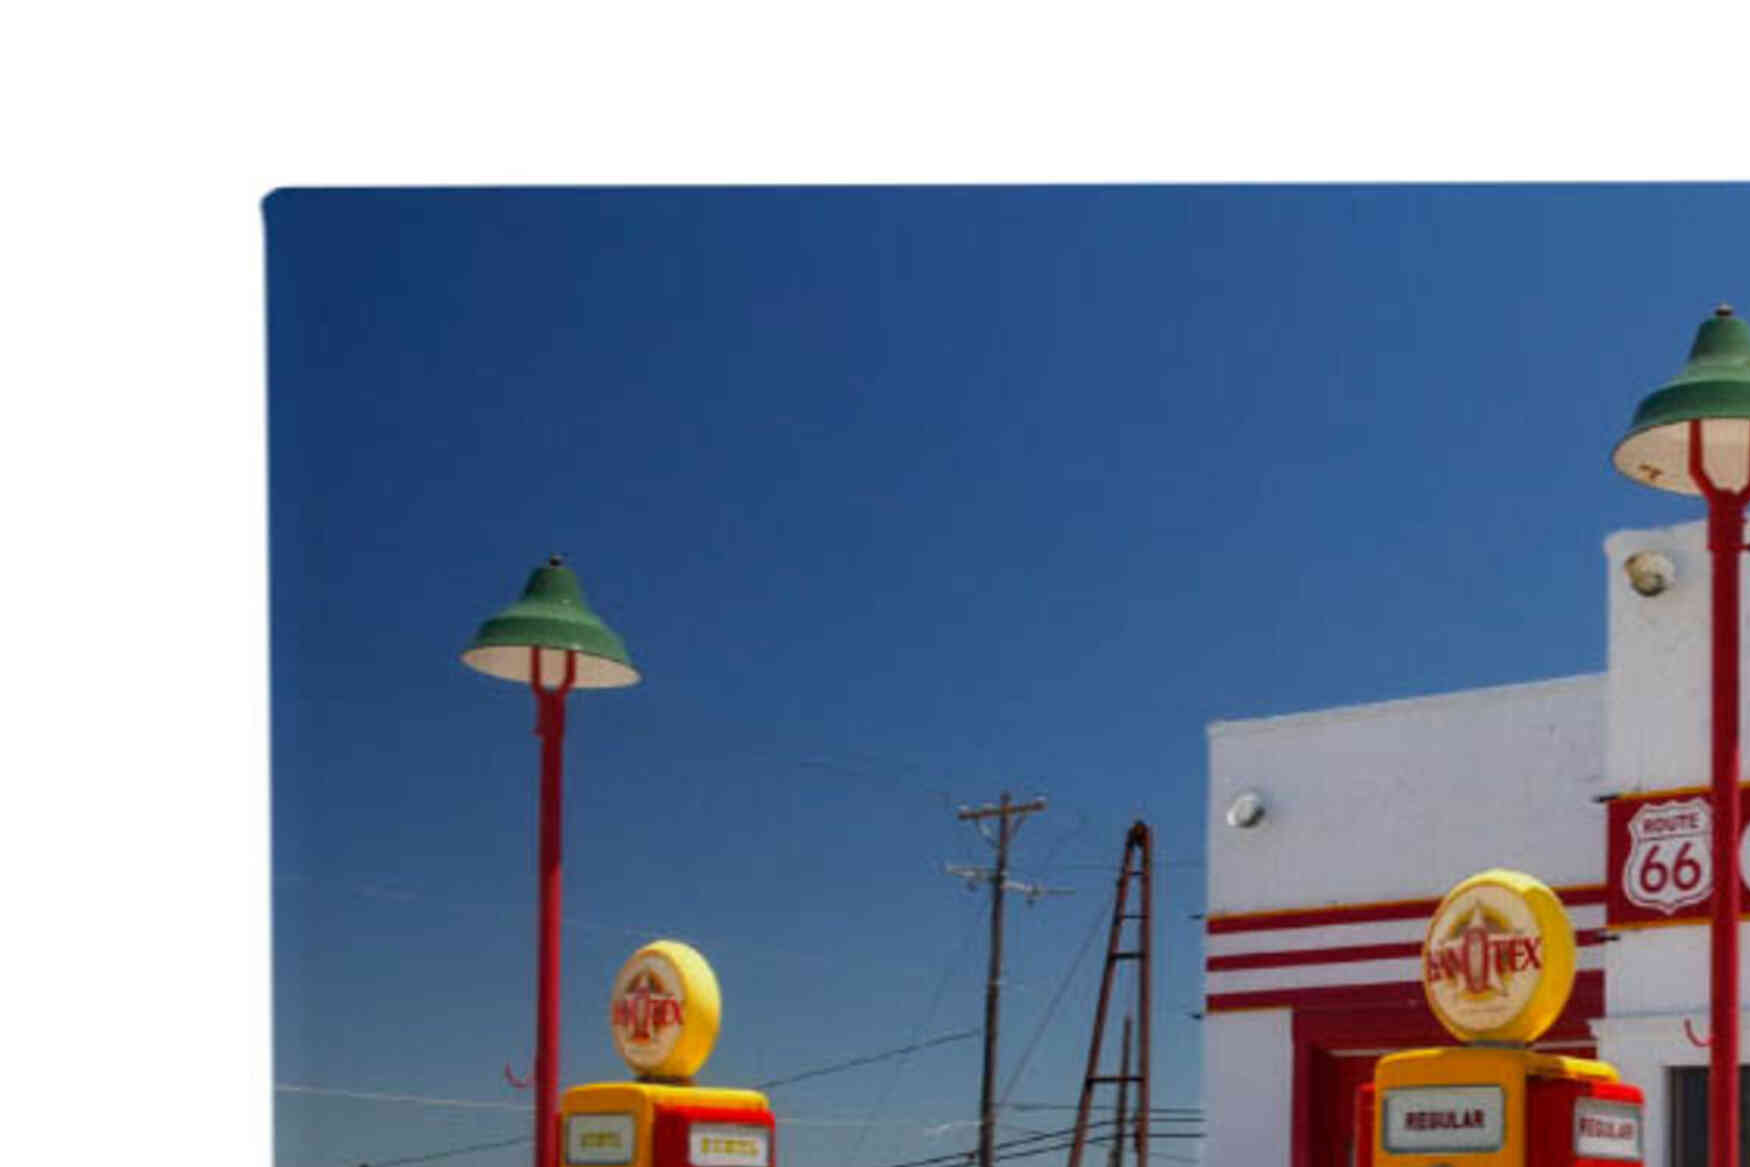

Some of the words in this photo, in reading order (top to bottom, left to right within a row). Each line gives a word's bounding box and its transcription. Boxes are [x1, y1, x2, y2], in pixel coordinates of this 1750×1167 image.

[1642, 811, 1701, 834] ROUTE
[1639, 842, 1702, 893] 66
[1404, 1109, 1486, 1132] REGULAR
